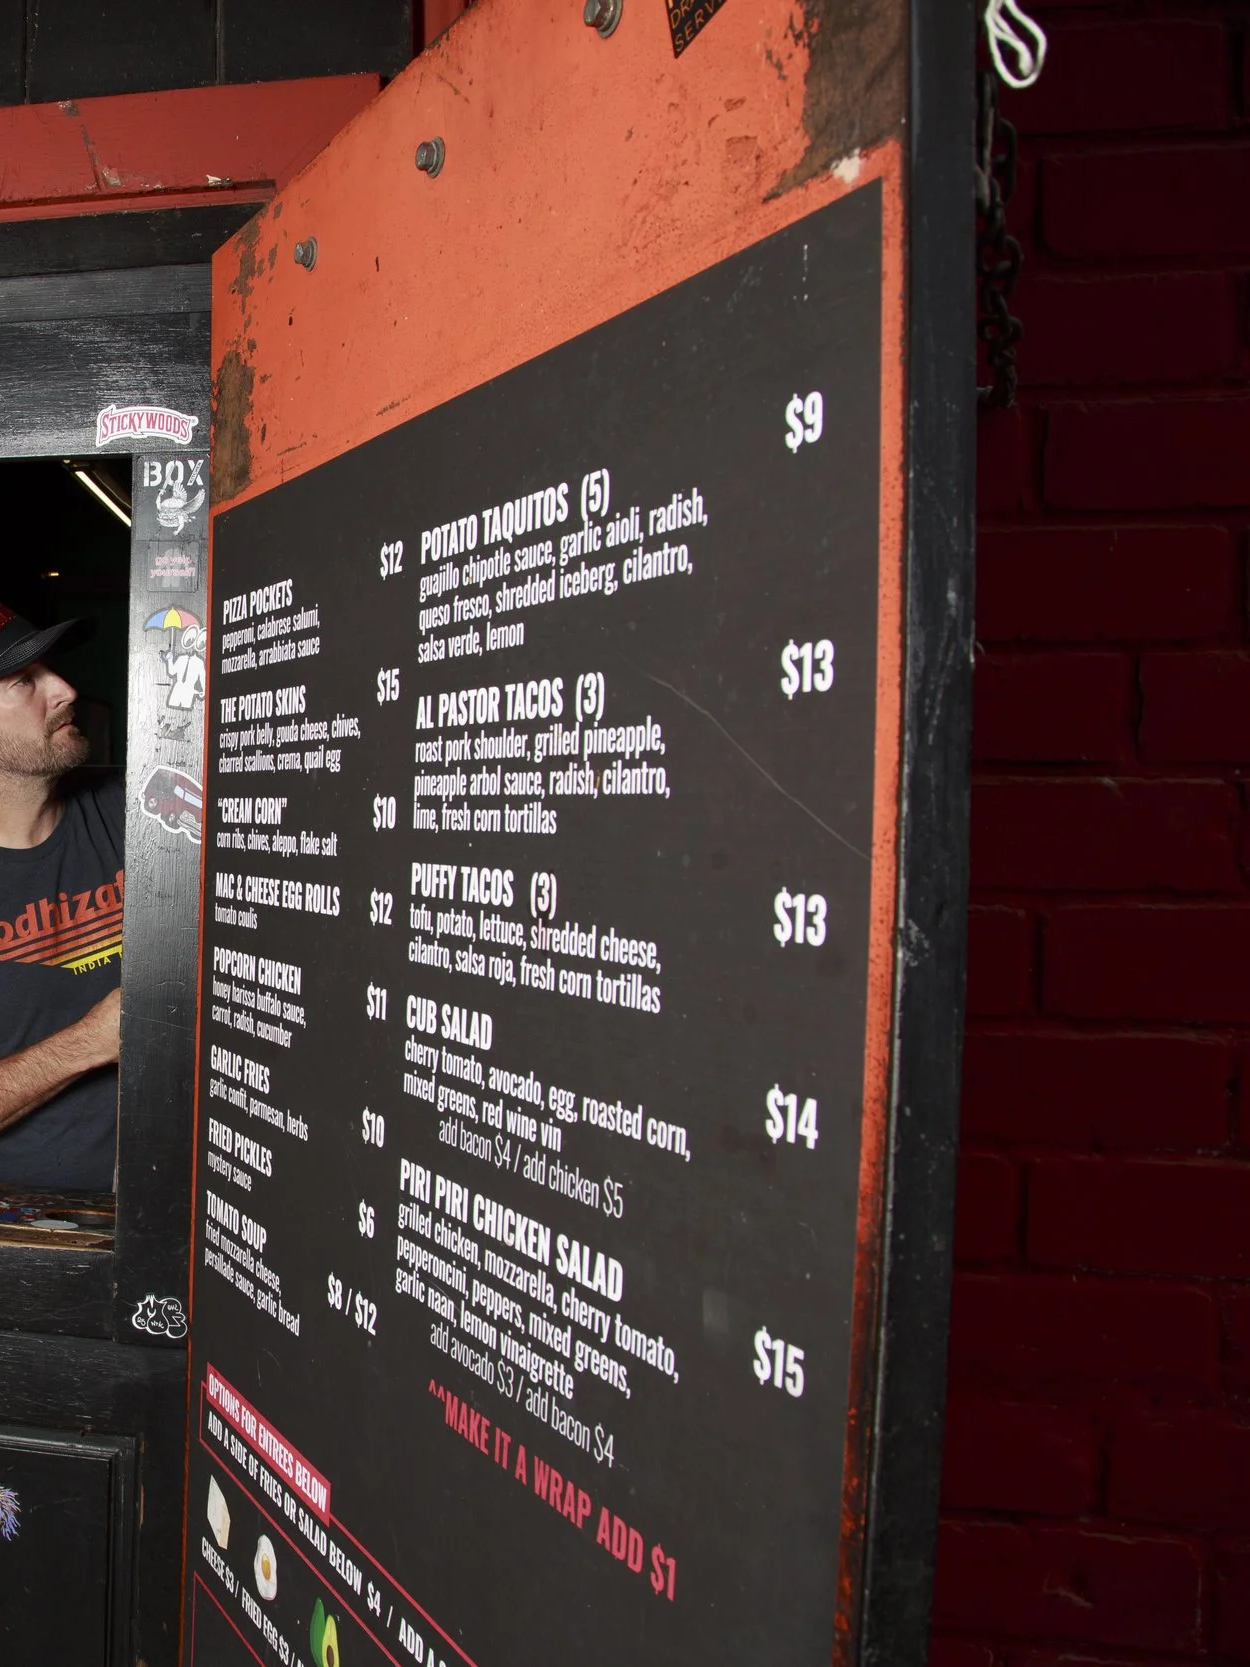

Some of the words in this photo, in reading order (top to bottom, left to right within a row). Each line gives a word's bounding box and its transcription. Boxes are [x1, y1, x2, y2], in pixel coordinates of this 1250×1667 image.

[101, 412, 189, 438] STICKYWOODS
[785, 391, 823, 453] $9
[143, 460, 204, 487] BOX
[421, 514, 478, 564] POTATO
[482, 482, 569, 545] TAQUITOS
[580, 468, 610, 522] (5)
[380, 540, 403, 580] $12
[419, 561, 459, 603] guajillo
[462, 546, 510, 591] chipotle
[514, 540, 556, 568] sauce,
[559, 520, 601, 567] garlic
[606, 506, 643, 548] aioli,
[648, 487, 707, 537] radish,
[223, 594, 247, 625] PIZZA
[250, 579, 293, 617] POCKETS
[221, 648, 257, 674] mozzarella,
[259, 639, 295, 666] arrabbiata
[297, 637, 320, 658] sauce
[781, 639, 835, 700] $13
[221, 698, 236, 723] THE
[239, 691, 273, 721] POTATO
[276, 685, 306, 716] SKINS
[377, 667, 400, 706] $15
[416, 696, 434, 729] AL
[438, 687, 499, 727] PASTOR
[505, 677, 563, 721] TACOS
[575, 672, 605, 722] (3)
[220, 729, 238, 751] crispy
[240, 725, 255, 751] pork
[257, 722, 274, 747] belly,
[276, 720, 298, 747] gouda
[301, 717, 329, 742] cheese,
[331, 713, 360, 739] chives,
[415, 735, 442, 763] roast
[445, 731, 471, 767] pork
[474, 727, 530, 761] shoulder,
[534, 722, 579, 763] grilled
[584, 715, 665, 761] pineapple,
[219, 751, 243, 773] charred
[244, 749, 275, 773] scallions,
[278, 749, 302, 771] crema,
[304, 745, 324, 774] quail
[326, 749, 341, 772] egg
[373, 793, 396, 832] $10
[413, 801, 439, 833] lime,
[442, 802, 470, 832] fresh
[474, 808, 500, 832] corn
[504, 802, 557, 834] tortillas
[217, 832, 230, 848] corn
[232, 828, 246, 852] ribs,
[248, 829, 270, 854] chives,
[272, 829, 298, 857] aleppo,
[300, 831, 319, 855] flake
[322, 832, 337, 856] salt
[215, 903, 236, 925] tomato
[238, 907, 258, 929] coulis
[216, 872, 234, 899] MAC
[237, 875, 242, 900] &
[246, 875, 280, 907] CHEESE
[282, 880, 302, 911] EGG
[305, 883, 340, 916] ROLLS
[370, 888, 393, 926] $12
[411, 862, 457, 897] PUFFY
[461, 866, 514, 907] TACOS
[530, 871, 557, 920] (3)
[410, 902, 433, 936] tofu,
[437, 912, 476, 942] potato,
[479, 910, 526, 951] lettuce,
[530, 917, 596, 960] shredded
[600, 927, 661, 974] cheese,
[773, 887, 827, 948] $13
[73, 956, 111, 975] INDIA
[214, 946, 256, 982] POPCORN
[258, 958, 301, 995] CHICKEN
[212, 1005, 232, 1028] carrot,
[234, 1010, 255, 1037] radish,
[257, 1020, 292, 1048] cucumber
[367, 982, 386, 1020] $11
[406, 995, 437, 1035] CUB
[441, 1004, 493, 1050] SALAD
[211, 1044, 242, 1081] GARLIC
[244, 1058, 270, 1094] FRIES
[404, 1035, 439, 1074] cherry
[442, 1046, 485, 1090] tomato,
[489, 1066, 545, 1111] avocado,
[549, 1085, 577, 1124] egg,
[582, 1095, 642, 1141] roasted
[647, 1116, 691, 1162] corn,
[766, 1084, 818, 1149] $14
[209, 1117, 232, 1153] FRIED
[235, 1131, 273, 1177] PICKLES
[362, 1106, 385, 1147] $10
[439, 1118, 458, 1150] add
[460, 1126, 491, 1162] bacon
[495, 1132, 511, 1170] $4
[523, 1150, 545, 1186] add
[548, 1158, 599, 1209] chicken
[603, 1176, 623, 1219] $5
[207, 1189, 239, 1235] TOMATO
[242, 1214, 267, 1253] SOUP
[358, 1199, 375, 1238] $6
[400, 1158, 430, 1204] PIRI
[435, 1174, 468, 1224] PIRI
[473, 1193, 551, 1266] CHICKEN
[556, 1233, 623, 1302] SALAD
[327, 1272, 342, 1310] $8
[355, 1291, 377, 1336] $12
[398, 1202, 432, 1237] grilled
[434, 1219, 481, 1271] chicken,
[484, 1248, 557, 1315] mozzarella,
[561, 1288, 610, 1344] cherry
[614, 1316, 678, 1384] tomato,
[396, 1267, 425, 1304] garlic
[428, 1286, 456, 1328] naan,
[460, 1301, 497, 1350] lemon
[500, 1330, 574, 1400] vinaigrette
[753, 1325, 805, 1398] $15
[209, 1373, 240, 1422] OPTIONS
[241, 1405, 256, 1441] FOR
[258, 1422, 293, 1478] ENTREES
[295, 1460, 326, 1512] BELOW
[208, 1410, 222, 1441] ADD
[224, 1428, 228, 1450] A
[230, 1434, 247, 1469] SIDE
[249, 1454, 258, 1480] OF
[260, 1465, 282, 1508] FRIES
[284, 1492, 296, 1525] OR
[298, 1507, 327, 1556] SALAD
[329, 1539, 362, 1596] BELOW
[367, 1581, 381, 1617] $4
[399, 1617, 423, 1663] ADD
[494, 1427, 511, 1470] IT
[515, 1445, 527, 1485] A
[534, 1456, 591, 1529] WRAP
[596, 1506, 643, 1574] ADD
[650, 1543, 676, 1602] $1
